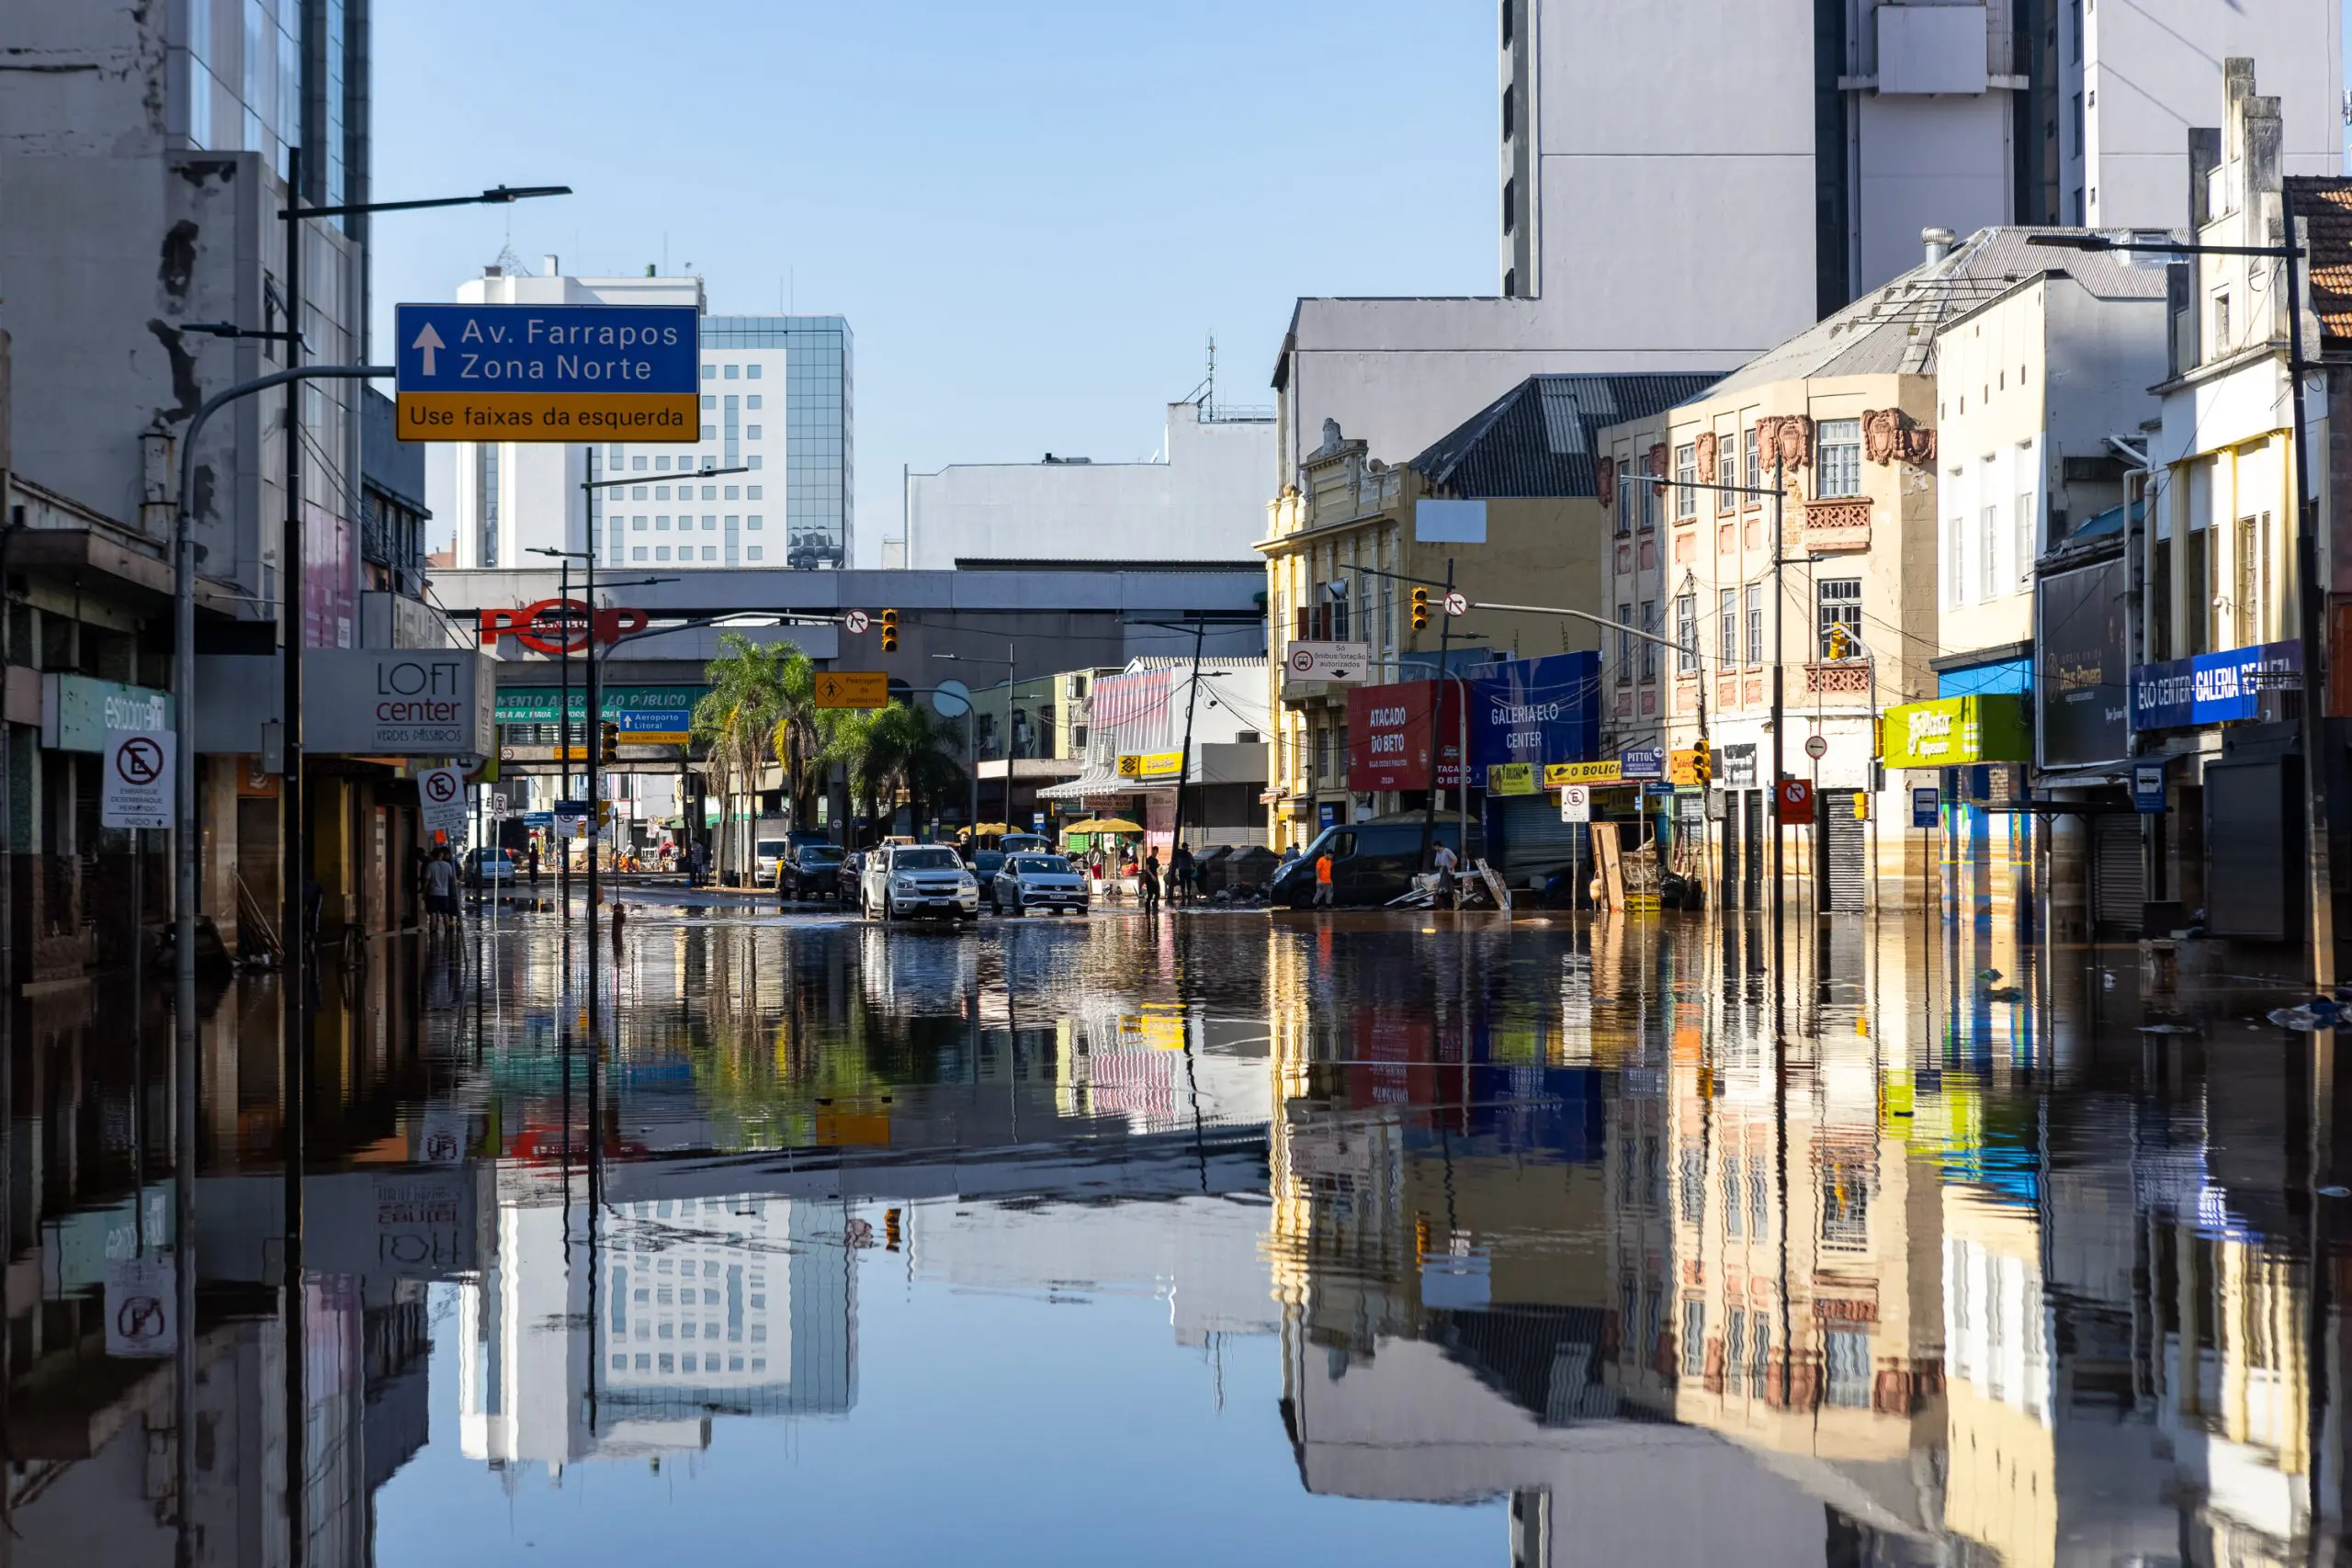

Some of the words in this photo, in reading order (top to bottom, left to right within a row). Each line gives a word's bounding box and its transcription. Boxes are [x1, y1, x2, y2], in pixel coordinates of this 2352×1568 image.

[460, 319, 514, 345] Av.
[527, 319, 678, 350] Farrapos
[460, 354, 544, 379] Zona
[557, 355, 653, 380] Norte
[410, 406, 455, 425] Use
[464, 406, 534, 426] faixas
[543, 406, 571, 426] da
[578, 407, 684, 431] esquerda
[536, 616, 588, 634] CENER
[378, 662, 460, 695] LOFT
[2138, 681, 2156, 710] ELO
[2158, 675, 2191, 706] CENTER
[2195, 665, 2239, 703] GALERIA
[377, 698, 461, 721] center
[634, 713, 679, 722] Aeroporto
[1370, 706, 1407, 728] ATACADO
[1491, 705, 1536, 725] GALERIA
[1536, 703, 1559, 722] ELO
[376, 729, 409, 741] VERDES
[413, 728, 462, 742] PÁSSAROS
[1371, 735, 1383, 753] DO
[1383, 733, 1405, 752] BETO
[1507, 731, 1542, 749] CENTER
[1627, 751, 1655, 762] PITTOL
[1570, 766, 1578, 777] O
